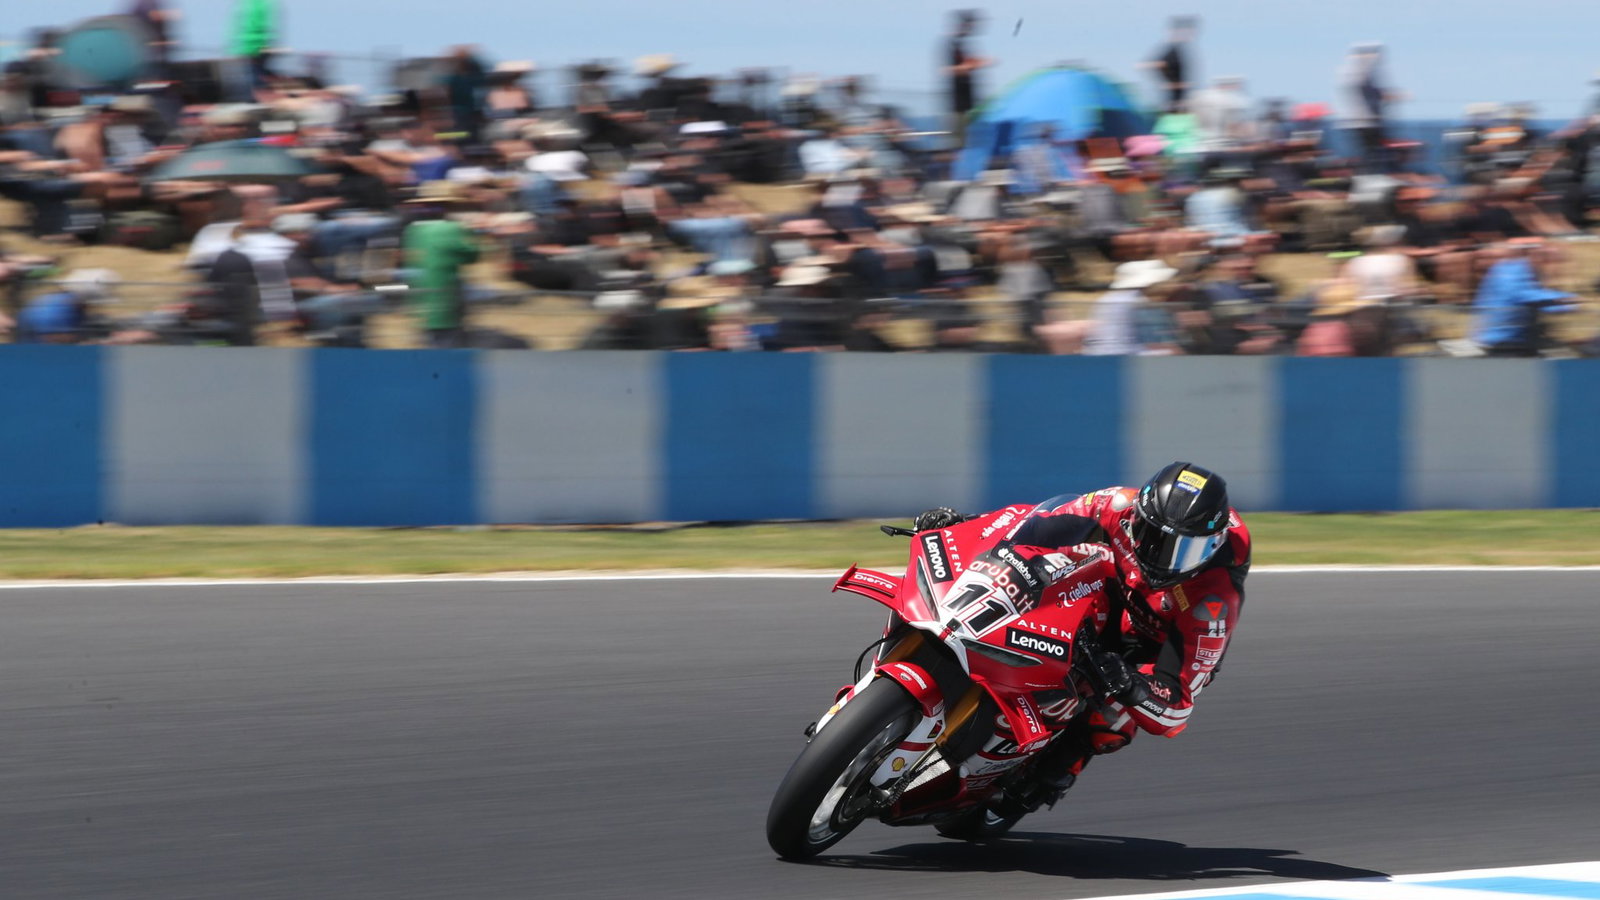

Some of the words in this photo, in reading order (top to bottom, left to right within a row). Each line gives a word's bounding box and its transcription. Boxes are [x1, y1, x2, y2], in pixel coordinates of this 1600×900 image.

[925, 535, 946, 579] Lenovo
[944, 529, 964, 572] ALTEN
[853, 573, 894, 590] Dierre
[969, 559, 1035, 615] aruba.it
[1069, 582, 1092, 602] riello
[1090, 579, 1103, 591] ups
[945, 581, 1011, 635] 11
[1011, 631, 1065, 658] Lenovo
[1017, 619, 1073, 640] ALTEN
[1017, 697, 1038, 733] Dierre
[1141, 700, 1163, 714] enovo
